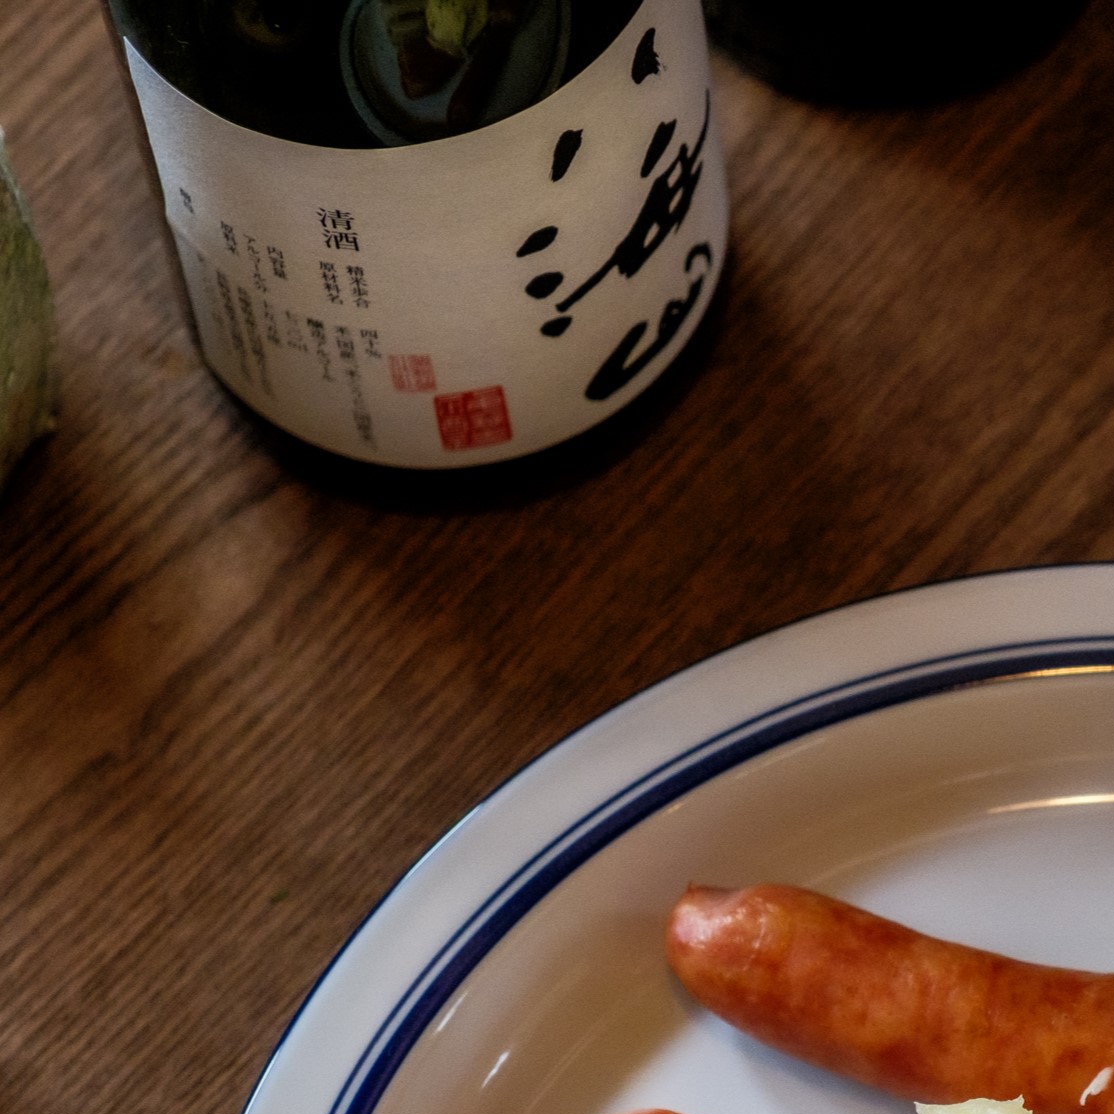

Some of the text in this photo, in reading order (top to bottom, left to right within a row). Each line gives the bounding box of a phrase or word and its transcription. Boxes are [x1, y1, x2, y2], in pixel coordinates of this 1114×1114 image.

[316, 207, 360, 252] 清酒
[319, 261, 344, 305] 原材料名
[345, 264, 370, 309] 精米歩合
